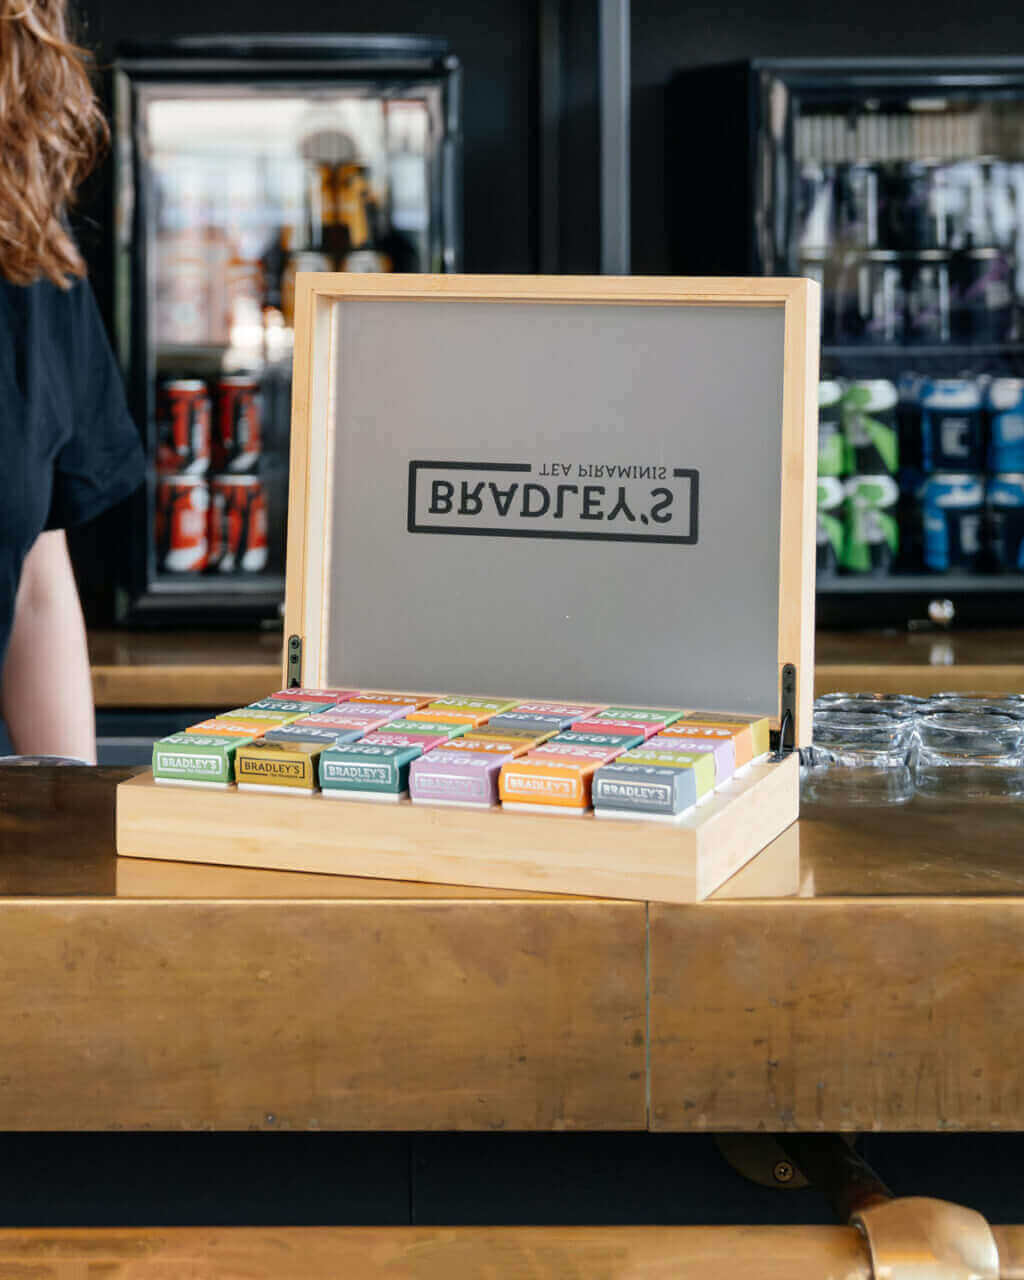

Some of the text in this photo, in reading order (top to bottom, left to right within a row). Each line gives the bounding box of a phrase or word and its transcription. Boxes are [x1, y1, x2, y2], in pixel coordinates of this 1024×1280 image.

[161, 757, 217, 770] BRADLEY'S
[244, 761, 300, 774] BRADLEY'S
[328, 767, 386, 780] BRADLEY'S
[603, 784, 666, 800] BRADLEY'S
